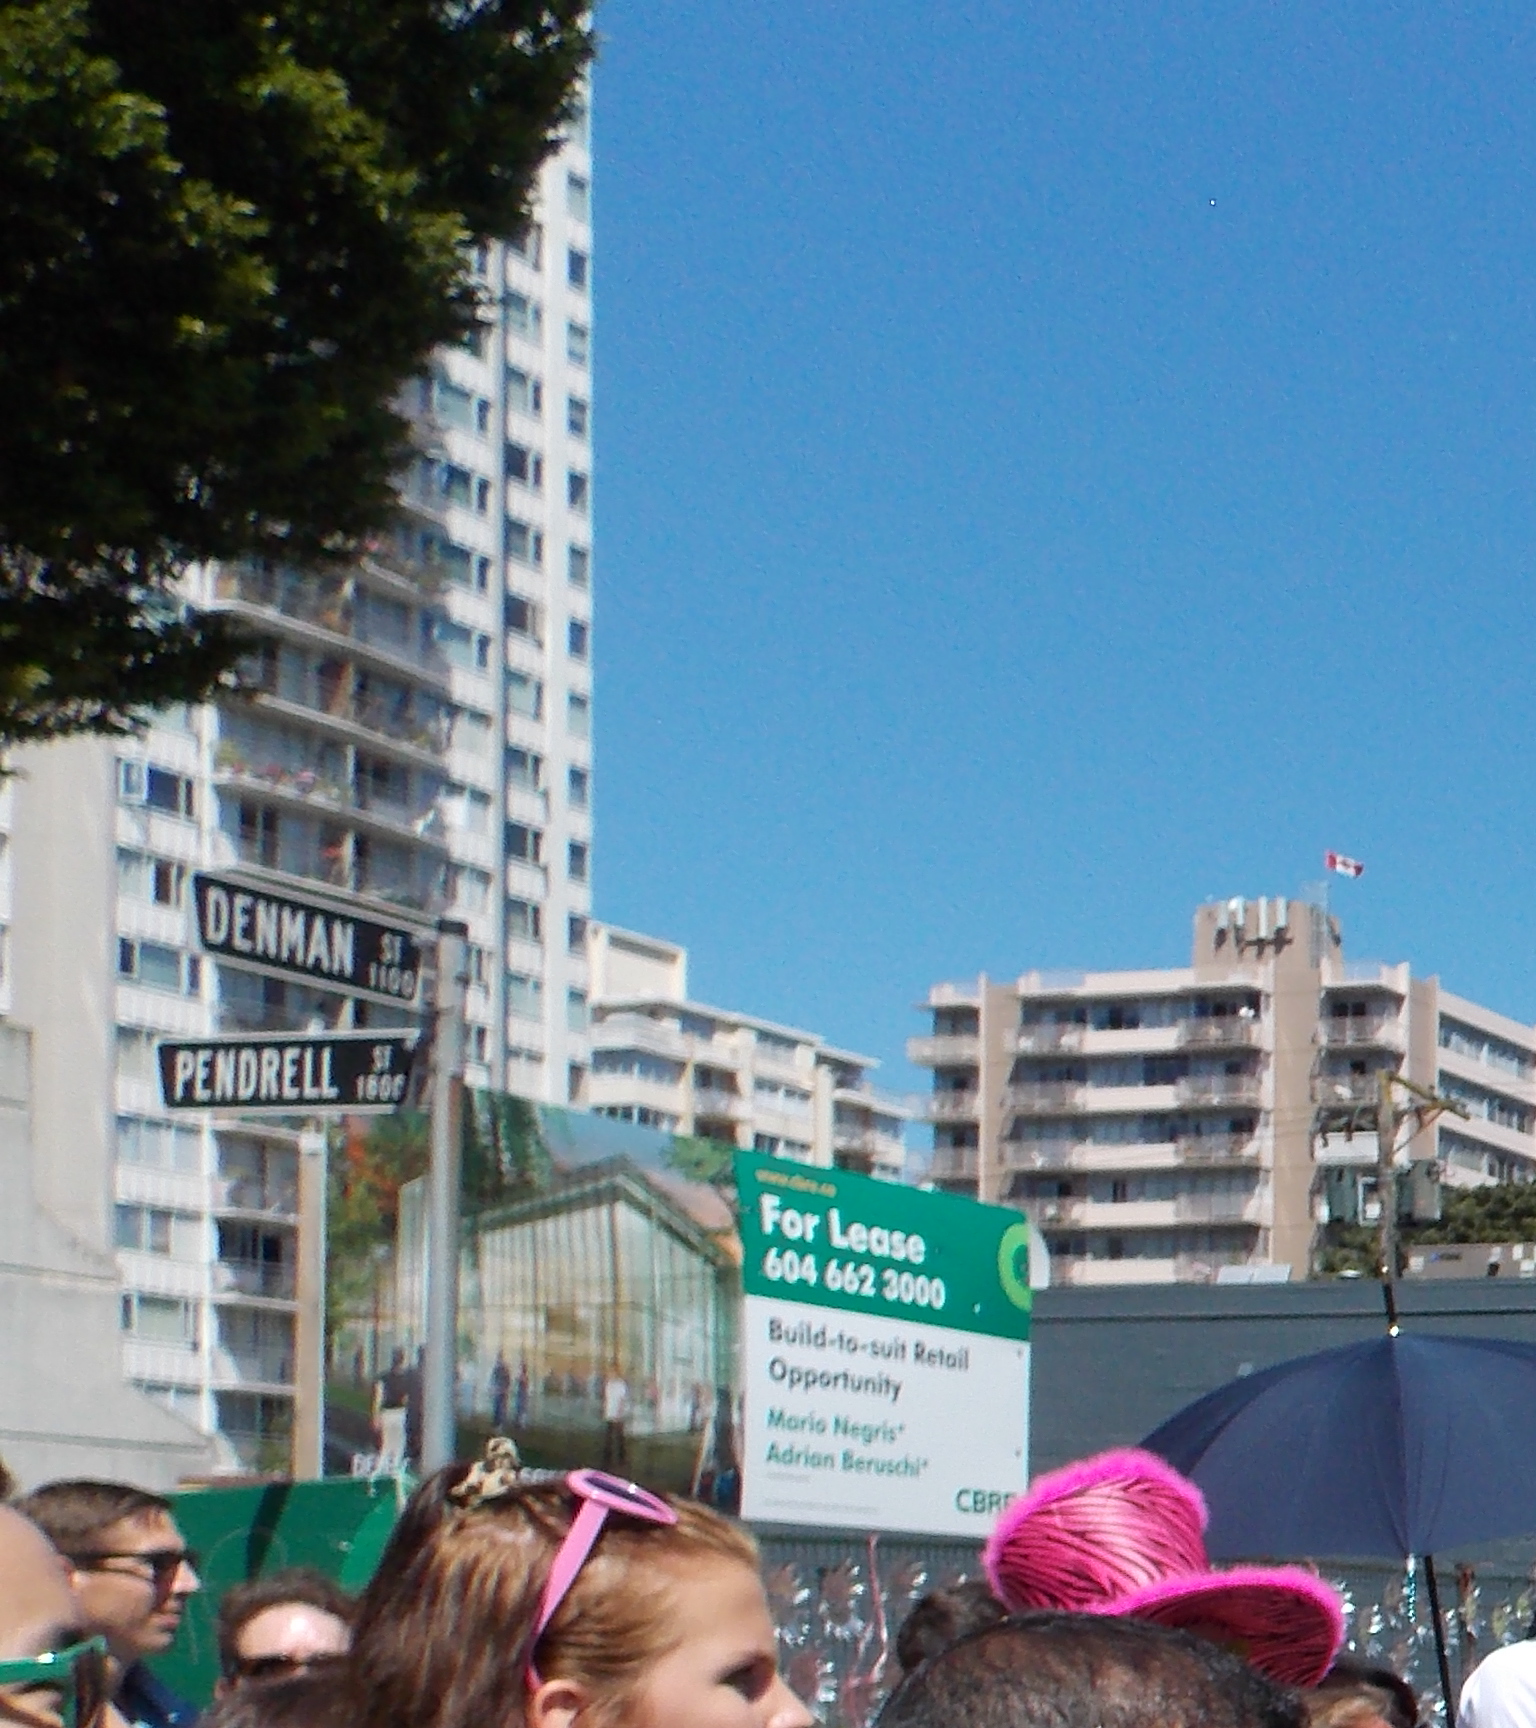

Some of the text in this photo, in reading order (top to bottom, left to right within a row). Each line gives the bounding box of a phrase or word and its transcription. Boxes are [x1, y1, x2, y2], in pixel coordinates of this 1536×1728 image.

[205, 885, 401, 978] DENMAN ST
[174, 1046, 340, 1101] PENDRELL
[759, 1192, 926, 1265] For Lease
[763, 1246, 946, 1310] 604 662 3000
[768, 1317, 970, 1371] Build-to-suit Retail
[768, 1355, 903, 1402] Opportunity
[766, 1407, 827, 1435] Mario
[766, 1441, 835, 1468] Adrian
